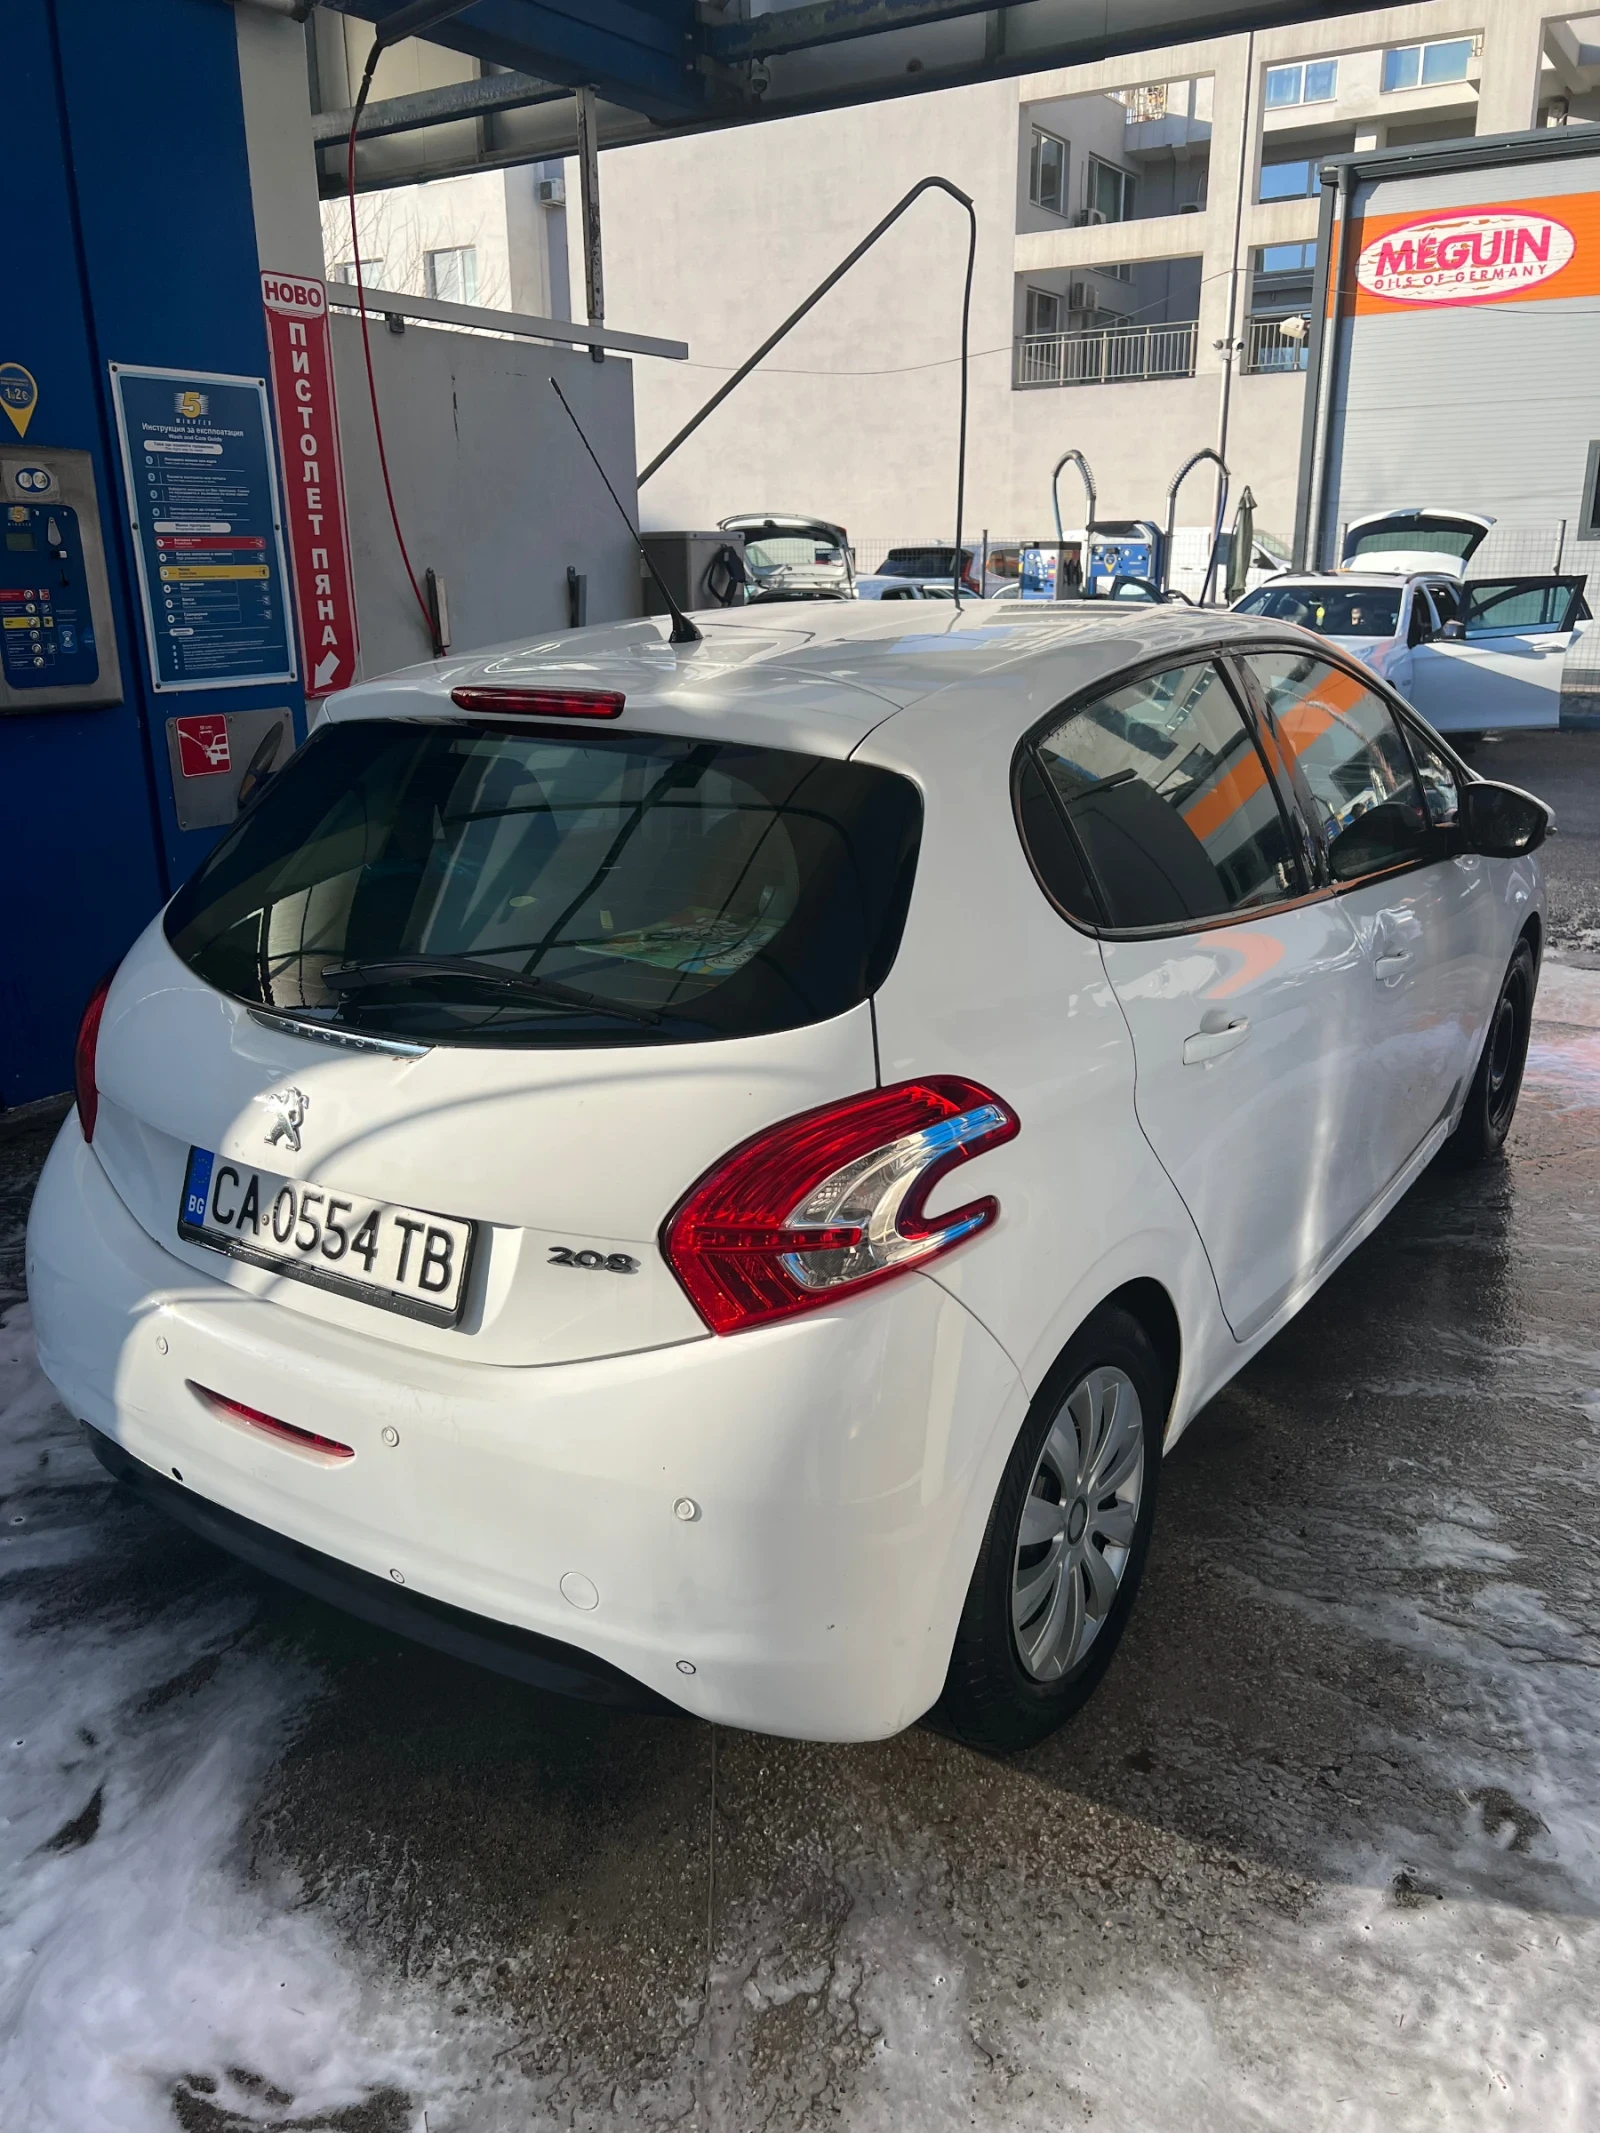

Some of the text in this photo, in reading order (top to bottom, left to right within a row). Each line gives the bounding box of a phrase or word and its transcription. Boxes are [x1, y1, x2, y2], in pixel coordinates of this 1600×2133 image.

[1374, 264, 1548, 289] OILS OF GERMANY
[264, 280, 322, 308] НОВО
[181, 391, 202, 418] 5
[289, 321, 338, 646] ПИСТОЛЕТ ПЯНА
[187, 1194, 205, 1216] BG
[211, 1166, 456, 1293] CA 0554 TB
[547, 1246, 633, 1274] 208
